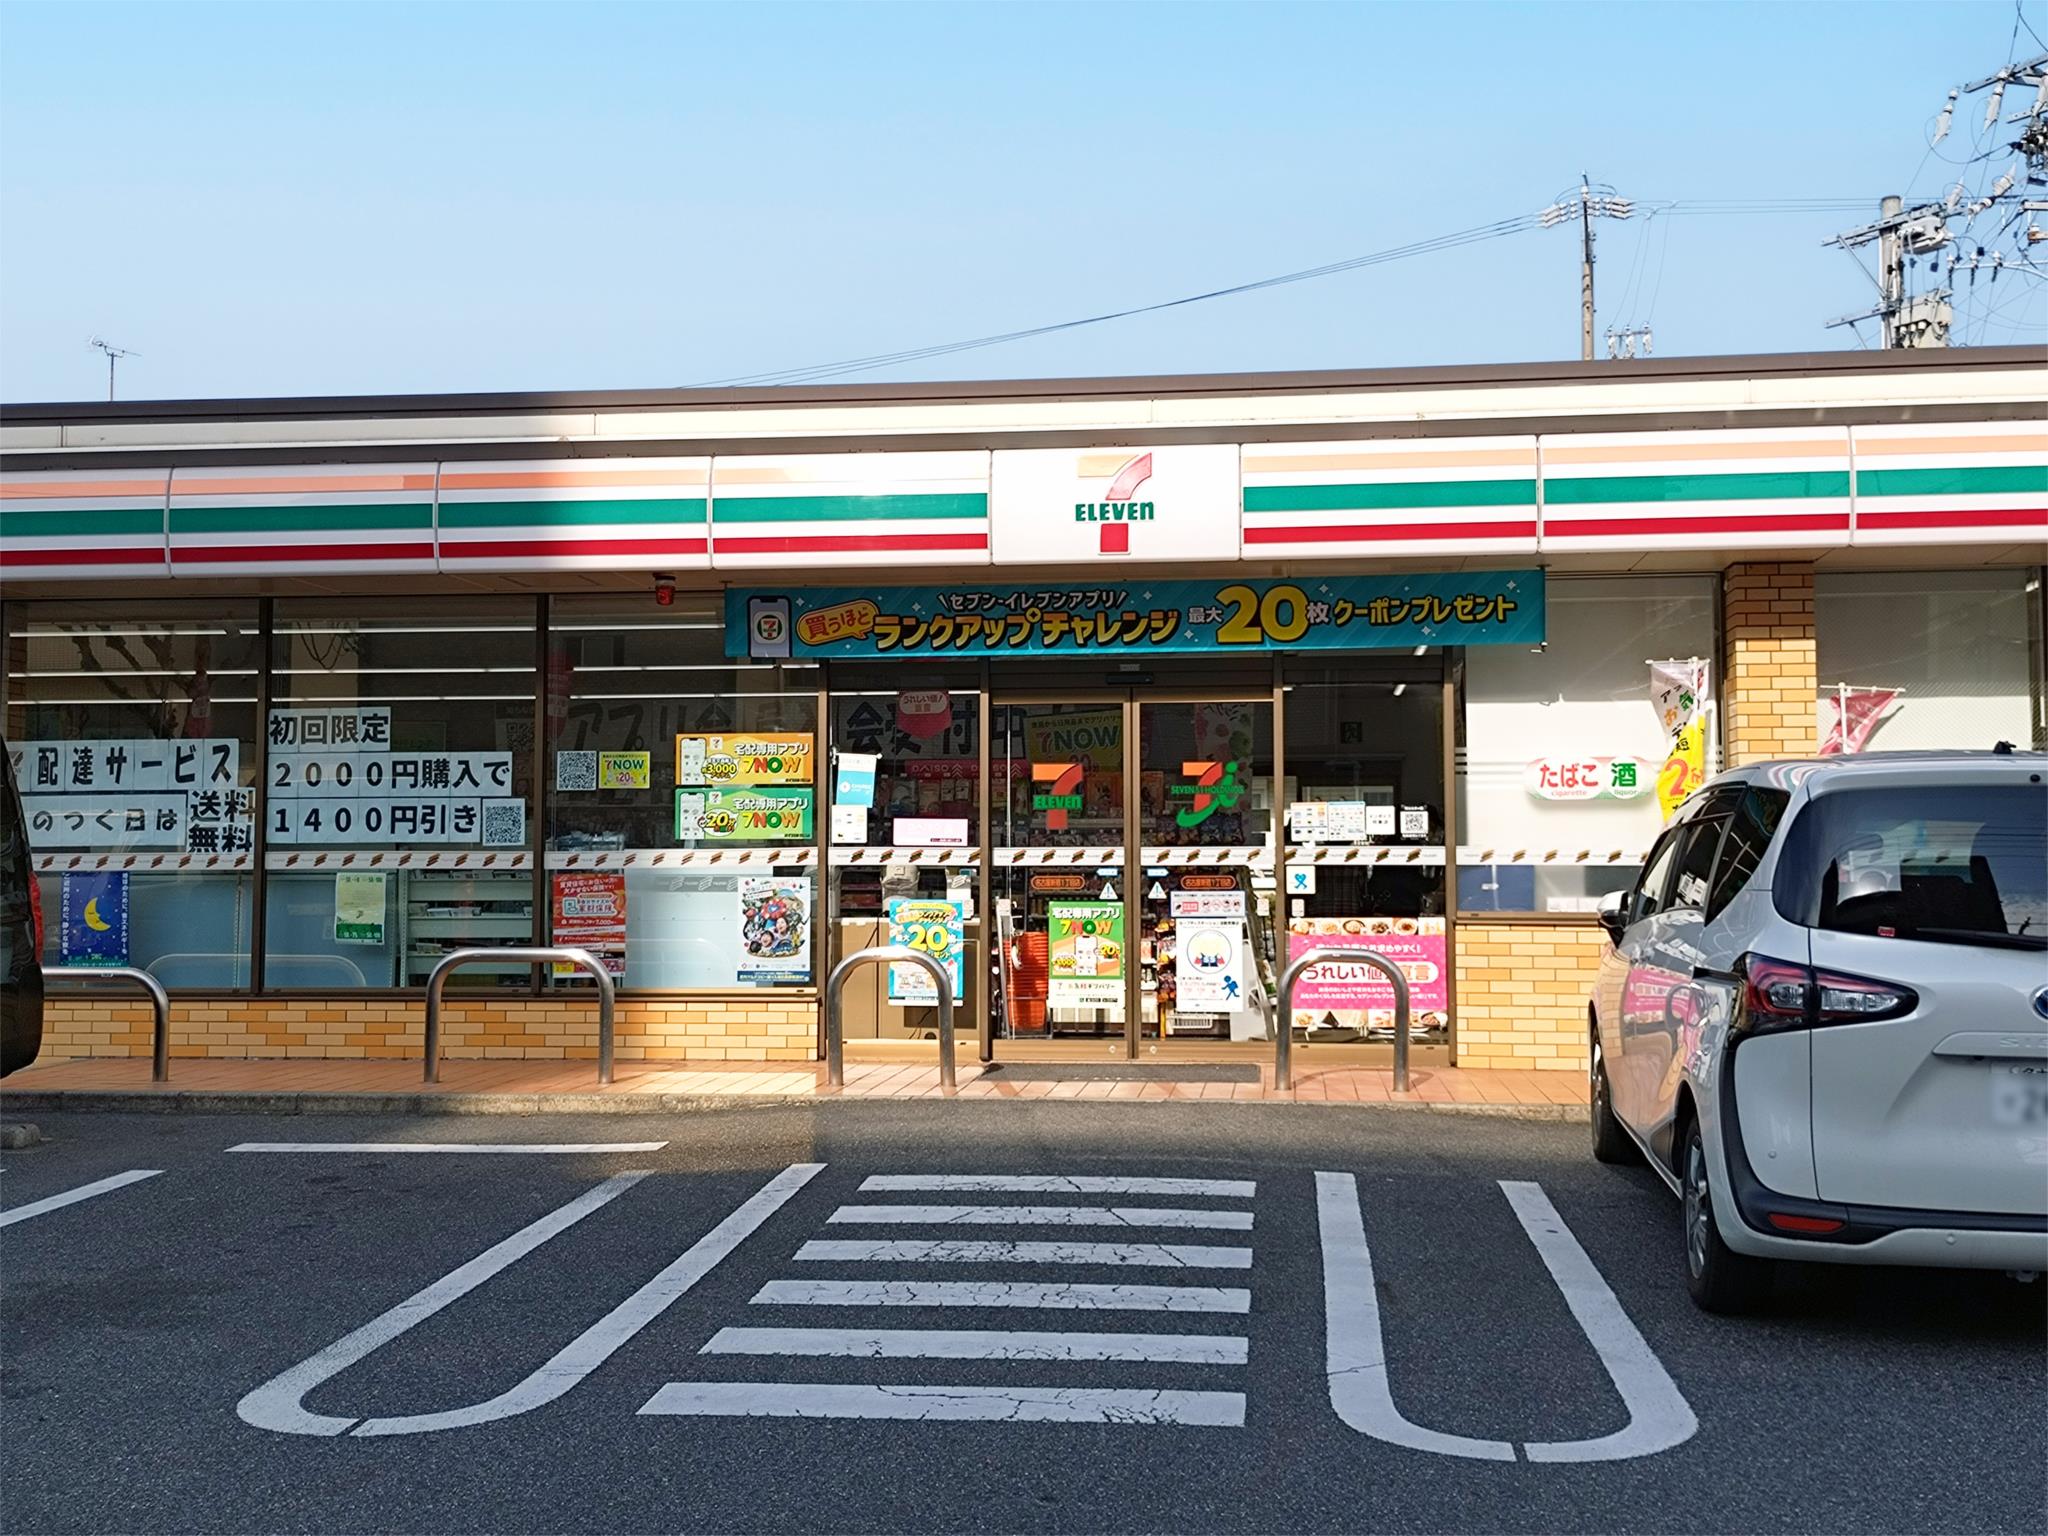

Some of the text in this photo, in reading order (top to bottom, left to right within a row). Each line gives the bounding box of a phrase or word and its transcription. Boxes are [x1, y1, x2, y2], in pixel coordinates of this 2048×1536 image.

[805, 606, 871, 640] 買うほど
[269, 713, 389, 745] 初回限定
[37, 743, 232, 785] 配達サービス
[274, 758, 510, 789] 2000円購入で
[743, 756, 802, 774] 7NOW
[1539, 762, 1637, 788] たばこ 酒
[1551, 789, 1638, 798] cigarette liquor
[274, 804, 478, 835] 1400円引き
[742, 811, 801, 829] 7NOW
[1060, 920, 1113, 935] 7NOW
